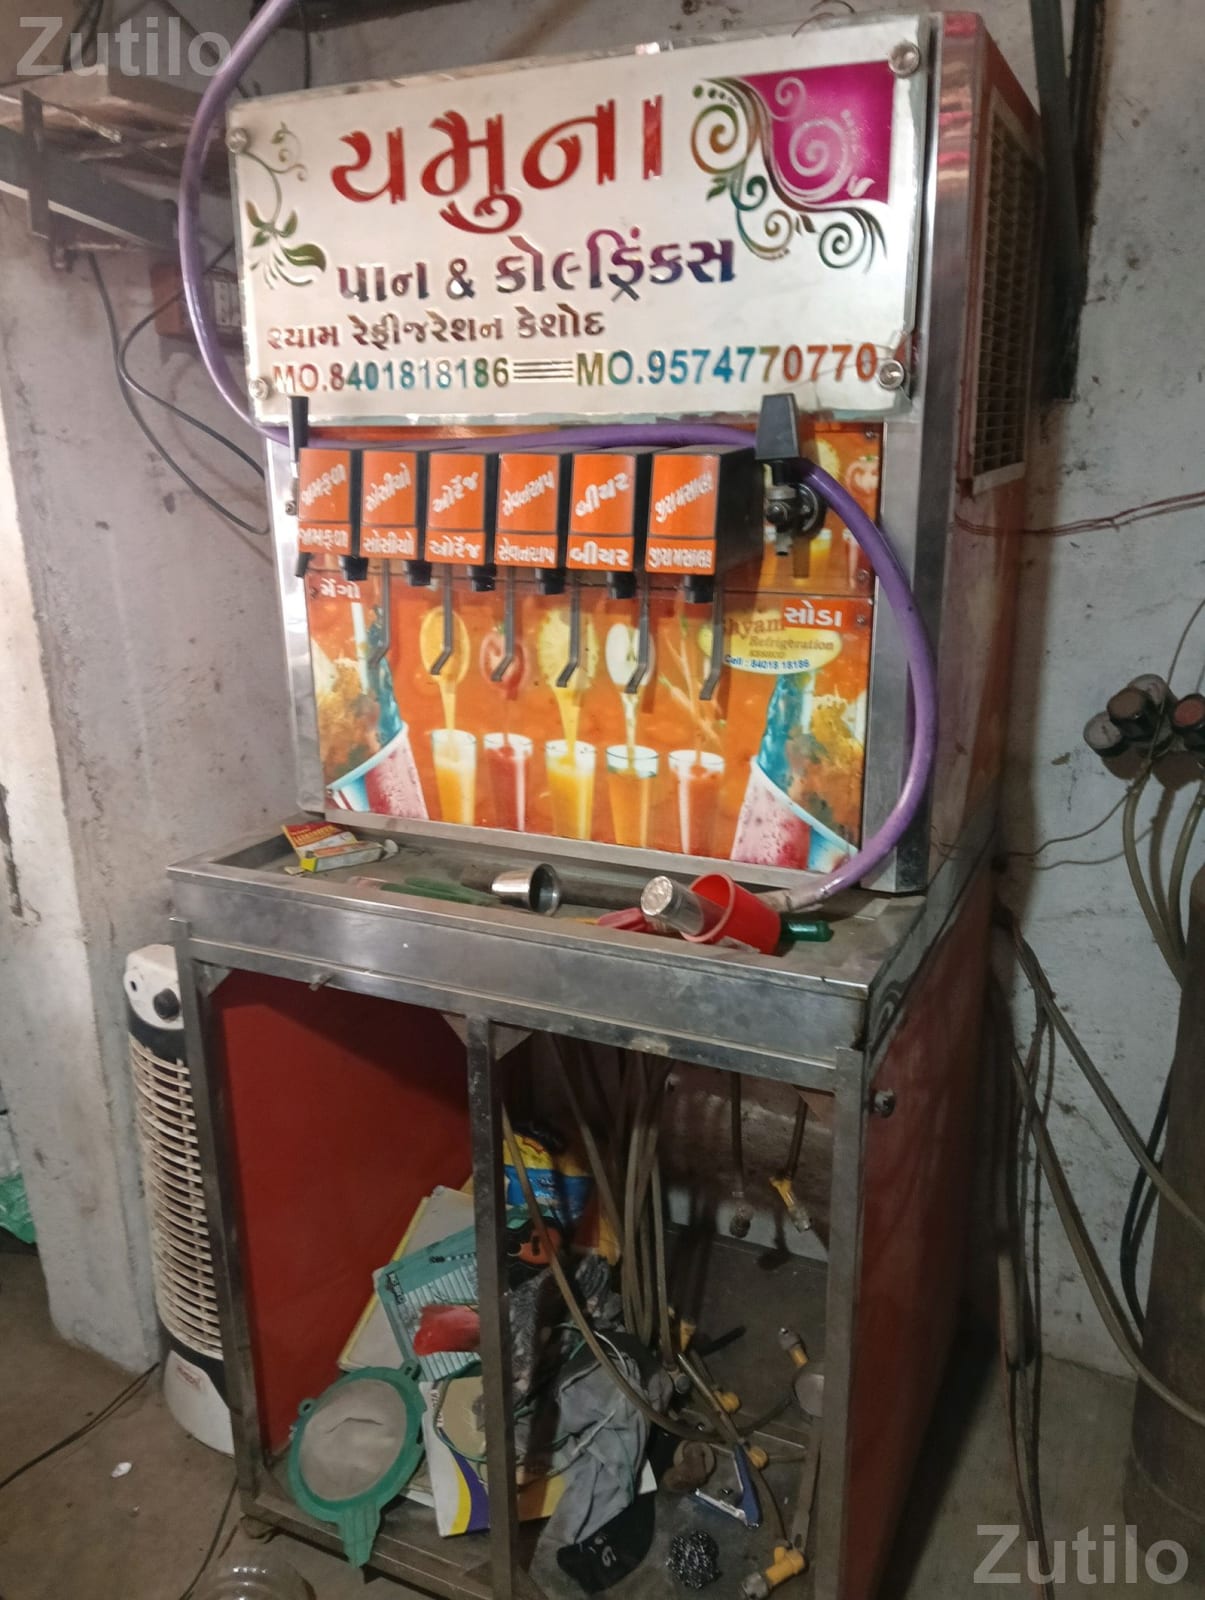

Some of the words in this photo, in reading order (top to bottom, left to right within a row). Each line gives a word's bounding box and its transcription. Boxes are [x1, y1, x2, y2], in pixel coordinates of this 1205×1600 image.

[330, 94, 663, 234] યમુના
[337, 262, 430, 302] પાન
[446, 258, 475, 299] &
[515, 303, 606, 339] કેશોદ
[273, 357, 510, 393] MO.8401818186
[576, 342, 878, 386] MO.9574770770
[569, 541, 629, 566] બીયર
[784, 600, 843, 627] સોડા
